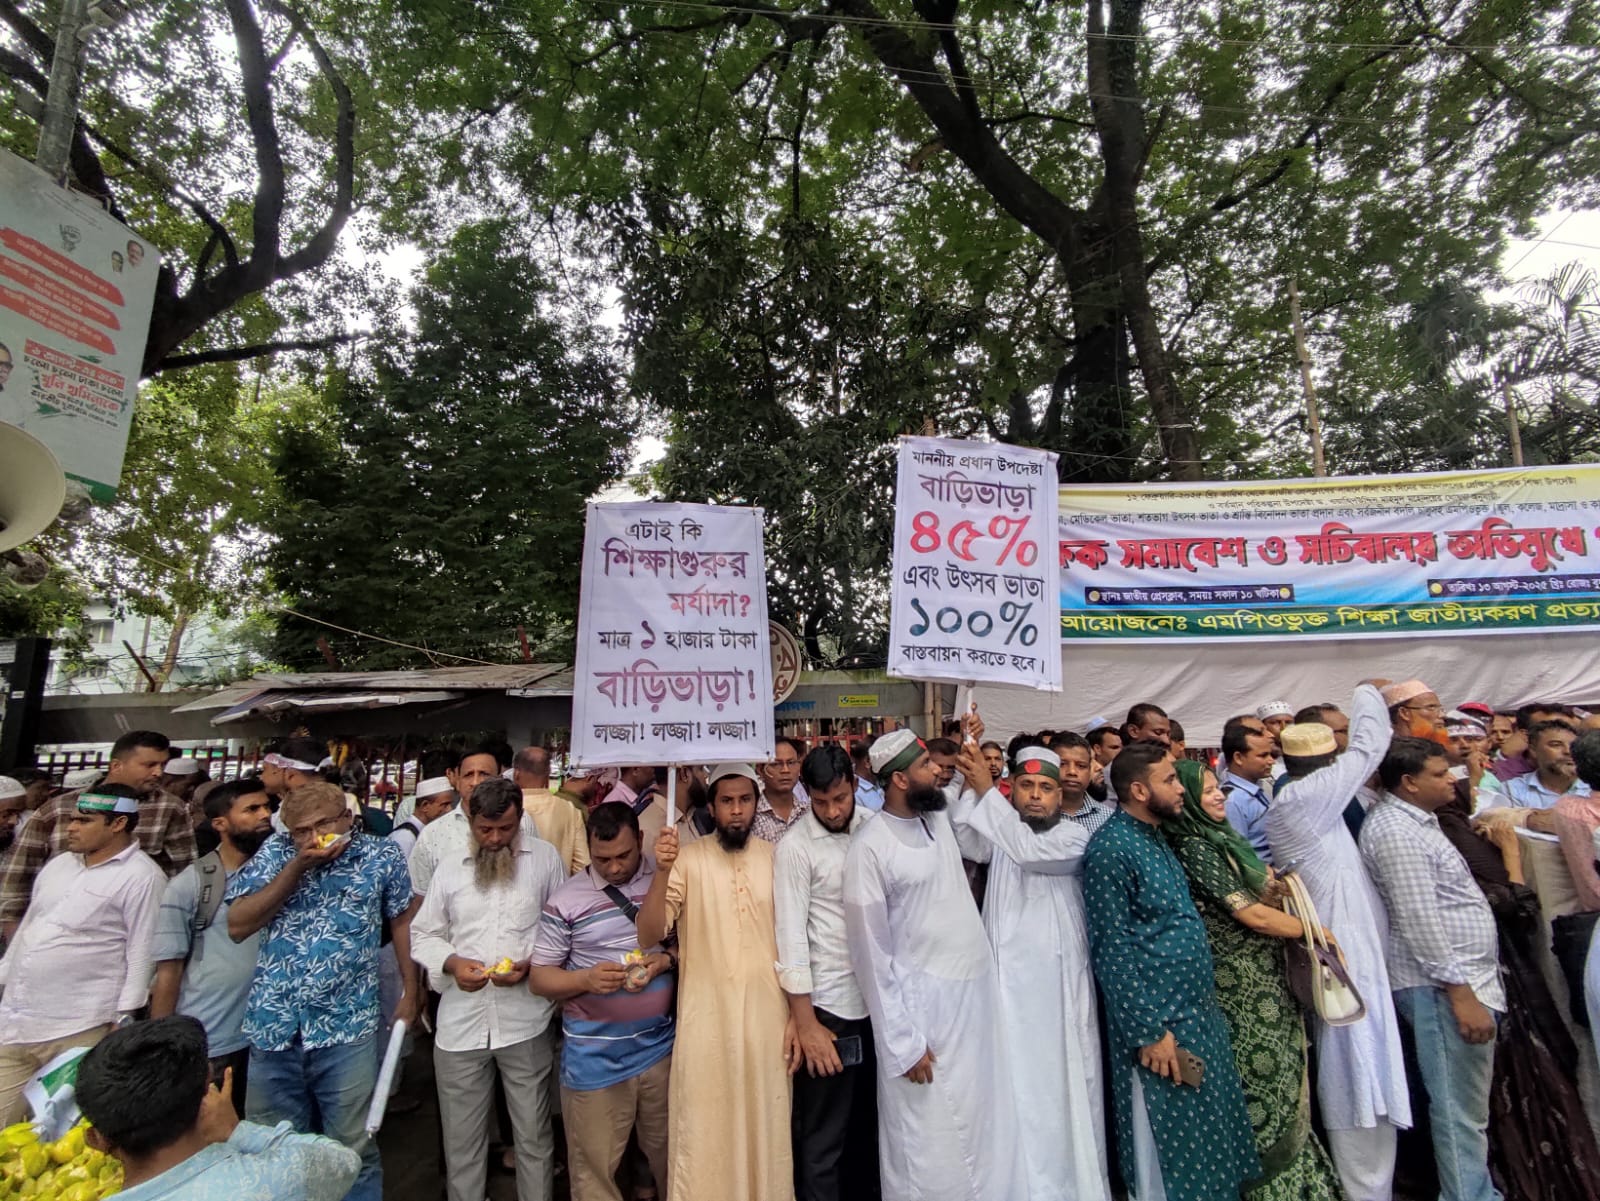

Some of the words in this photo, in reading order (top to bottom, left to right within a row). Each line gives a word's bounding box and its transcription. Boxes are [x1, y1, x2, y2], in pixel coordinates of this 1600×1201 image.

[912, 449, 956, 469] মাননীয়
[959, 456, 994, 471] প্রধান
[996, 456, 1044, 476] উপদেষ্টা
[918, 471, 1036, 513] বাড়িভাড়া
[1216, 500, 1244, 510] বর্তমান
[1070, 513, 1107, 525] মেডিকেল
[1111, 513, 1135, 525] ভাতা,
[1137, 512, 1168, 524] শতভাগ
[1172, 511, 1196, 522] উৎসব
[1200, 511, 1219, 522] ভাতা
[1222, 512, 1230, 521] ও
[1255, 508, 1287, 520] বিনোদন
[1289, 509, 1310, 520] ভাতা
[1312, 508, 1334, 519] প্রদান
[1337, 507, 1355, 519] এবং
[1548, 501, 1577, 512] মাদ্রাসা
[625, 518, 674, 542] এটাই
[679, 517, 704, 541] কি
[910, 510, 1039, 567] ৪৫%
[1116, 537, 1248, 571] সমাবেশ
[1257, 536, 1288, 566] ও
[1295, 521, 1439, 567] সচিবালয়
[1444, 517, 1588, 572] অভিমুখে
[600, 537, 749, 580] শিক্ষাগুরুর
[903, 564, 941, 590] এবং
[945, 561, 998, 596] উৎসব
[1003, 573, 1045, 601] ভাতা
[1122, 589, 1148, 602] জাতীয়
[1214, 590, 1239, 601] সকাল
[1241, 590, 1253, 600] ১০
[1256, 588, 1280, 600] ঘটিকা
[1478, 583, 1491, 593] ১৩
[667, 583, 751, 618] মর্যাদা?
[909, 598, 1039, 646] ১০০%
[1060, 613, 1188, 632] আয়োজনেঃ
[1197, 609, 1329, 633] এমপিওভুক্ত
[1336, 606, 1399, 627] শিক্ষা
[1406, 601, 1538, 625] জাতীয়করণ
[598, 629, 632, 649] মাত্র
[641, 620, 656, 650] ১
[664, 630, 715, 651] হাজার
[719, 627, 758, 650] টাকা
[901, 644, 963, 663] বাস্তবায়ন
[967, 648, 1006, 666] করতে
[592, 658, 756, 713] বাড়িভাড়া!
[593, 721, 645, 744] লজ্জা!
[651, 720, 702, 742] লজ্জা!
[707, 718, 757, 741] লজ্জা!
